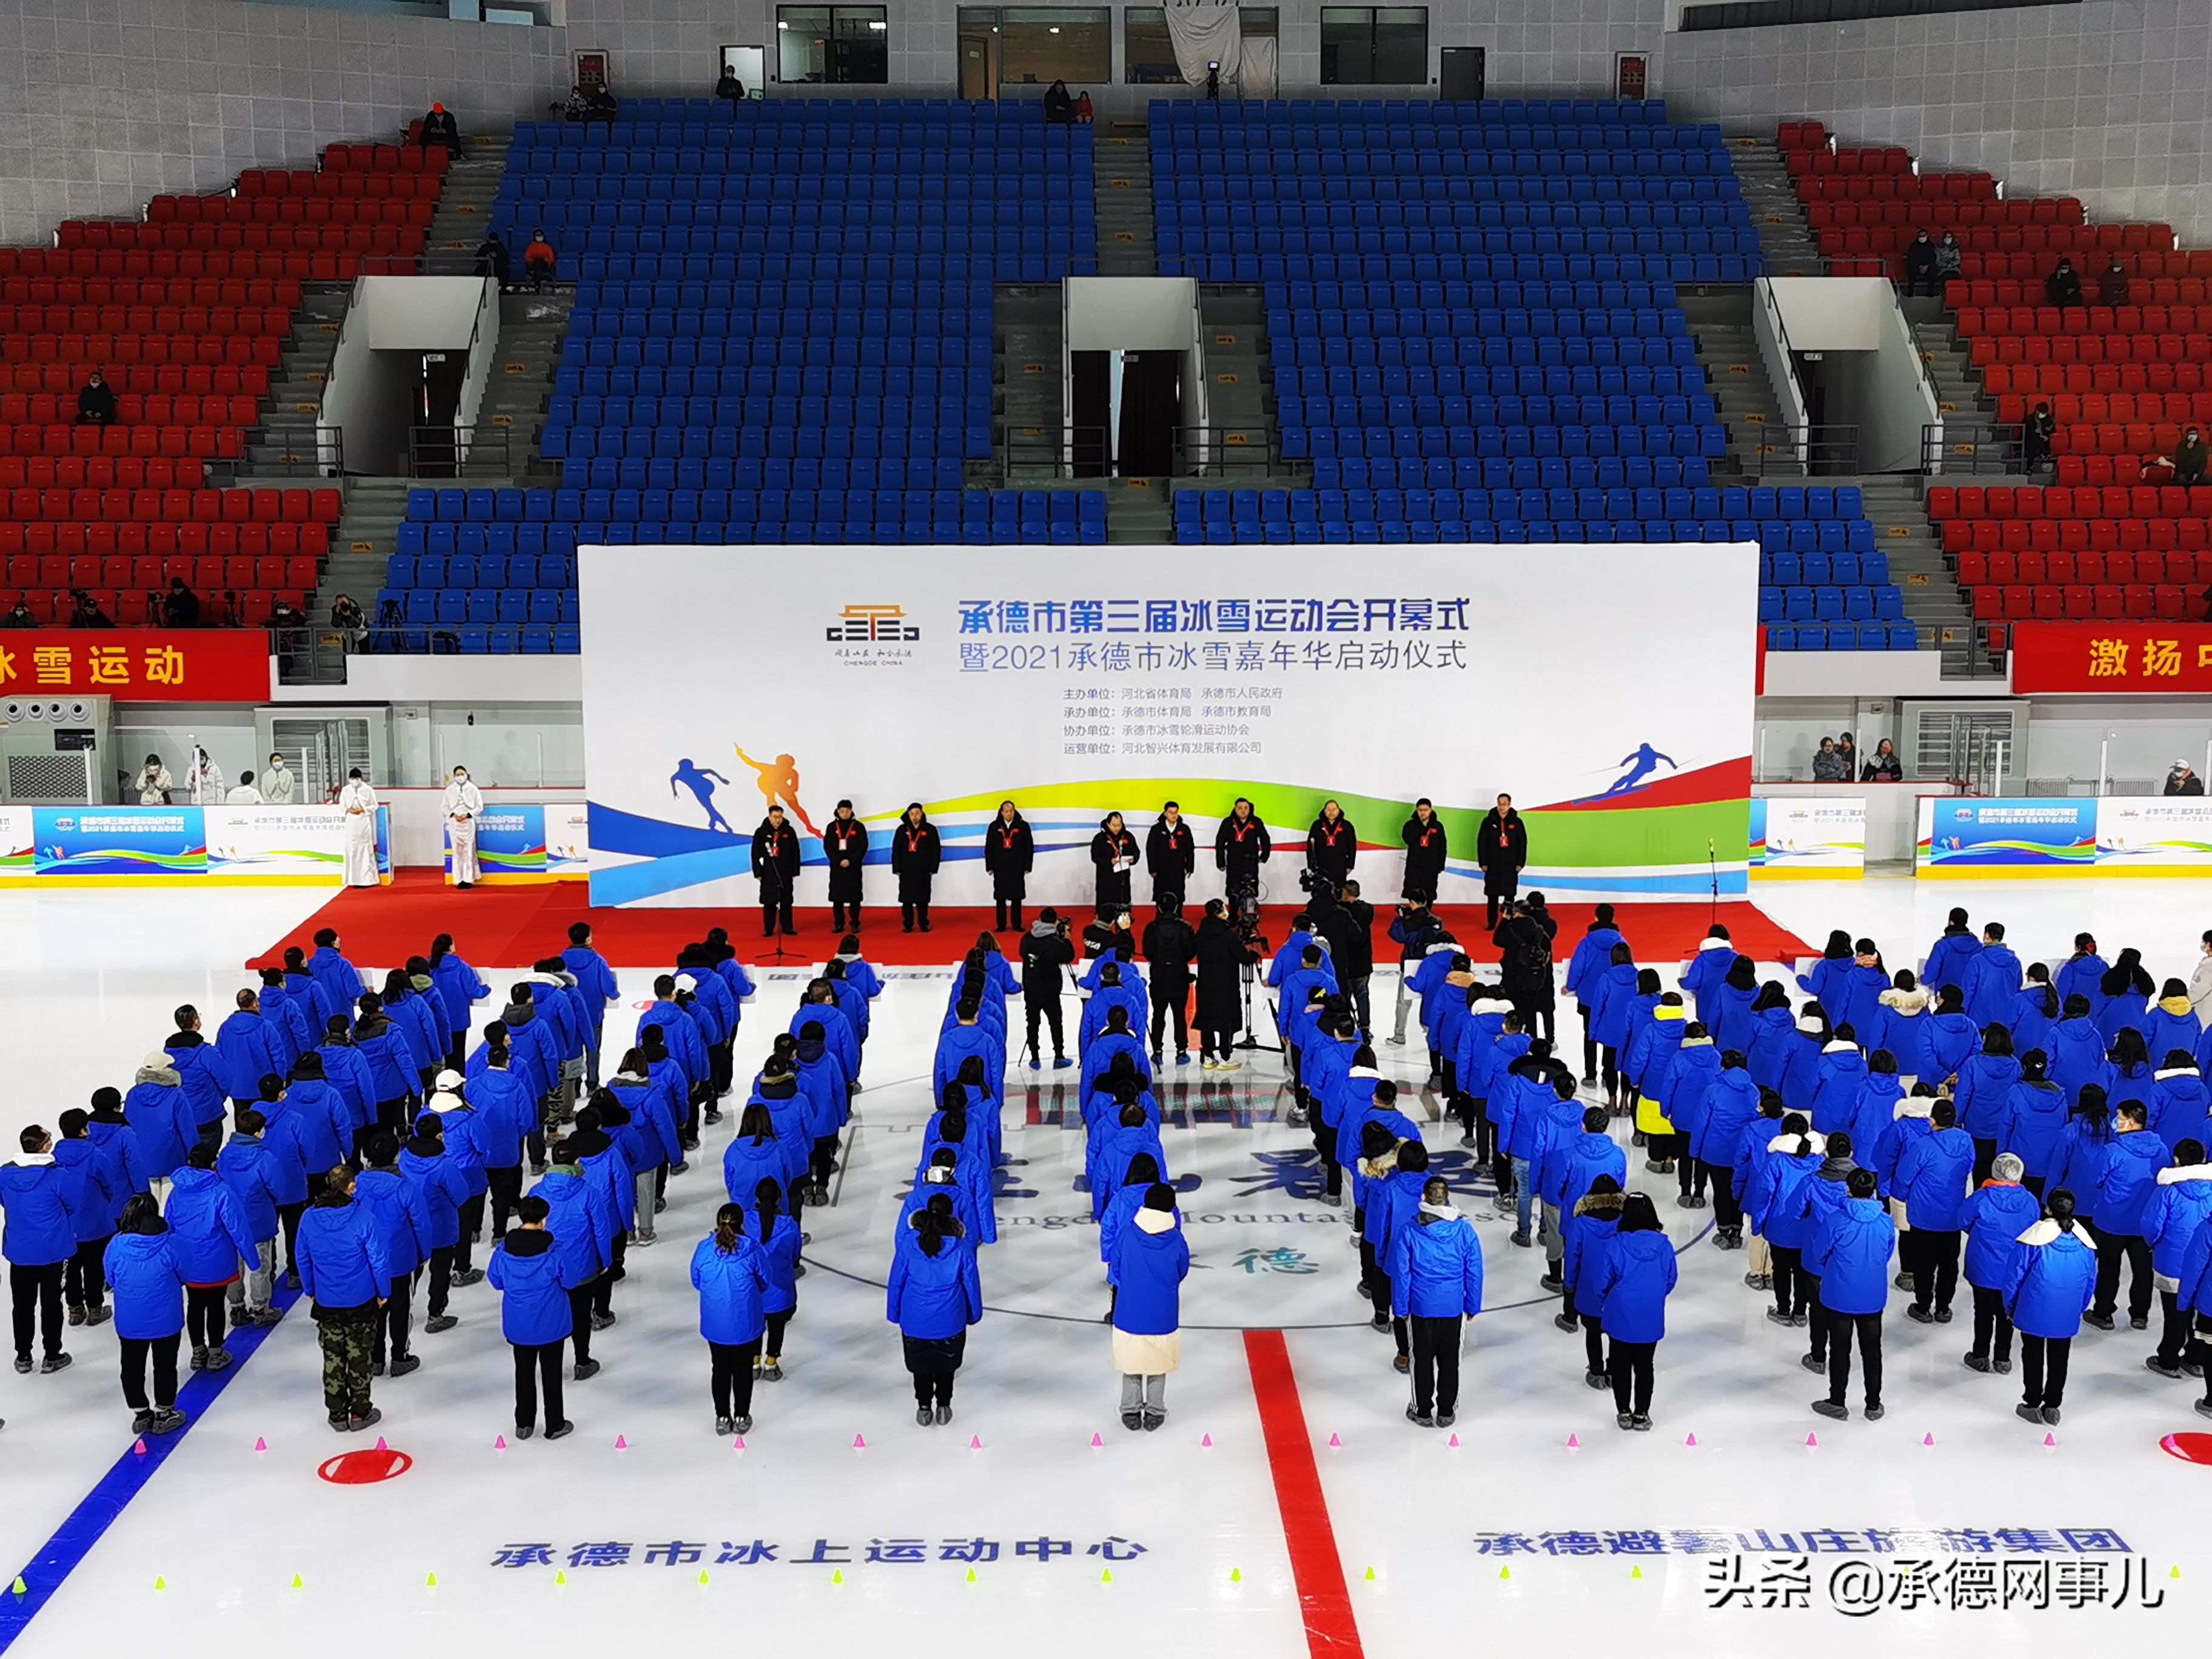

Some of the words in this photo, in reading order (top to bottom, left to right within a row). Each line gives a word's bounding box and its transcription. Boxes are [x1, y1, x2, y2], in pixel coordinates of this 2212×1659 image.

[958, 597, 1470, 634] 承德市第三届冰雪运动会开幕式
[959, 640, 1467, 672] 暨2021承德市冰雪嘉年华启动仪式
[1201, 687, 1283, 700] 承德市人民政府
[1201, 705, 1272, 718] 承德市教育局
[491, 1535, 1149, 1568] 承德市冰上运动中心
